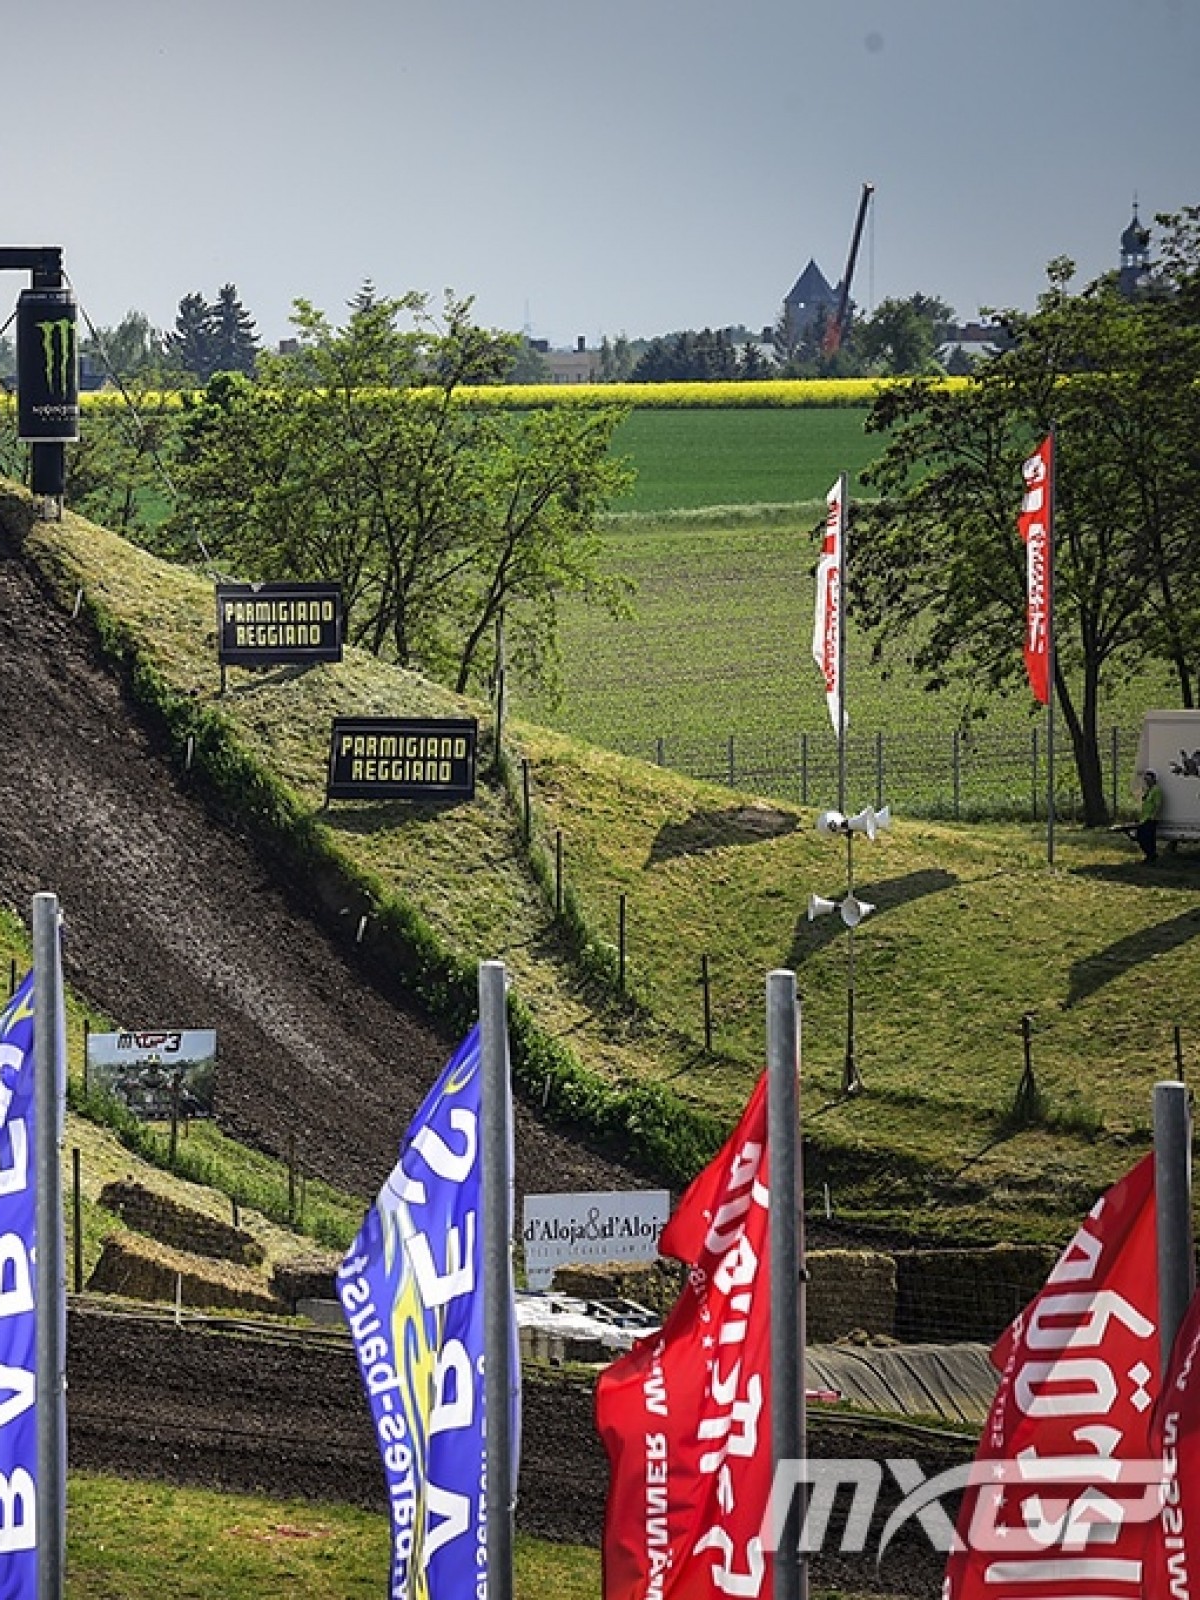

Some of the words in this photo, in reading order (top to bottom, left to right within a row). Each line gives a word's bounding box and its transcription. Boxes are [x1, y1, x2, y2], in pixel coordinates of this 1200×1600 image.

[225, 601, 333, 623] PARMIGIANO
[236, 625, 320, 646] REGGIANO
[341, 735, 466, 759] PARMIGIANO
[352, 760, 452, 781] REGGIANO
